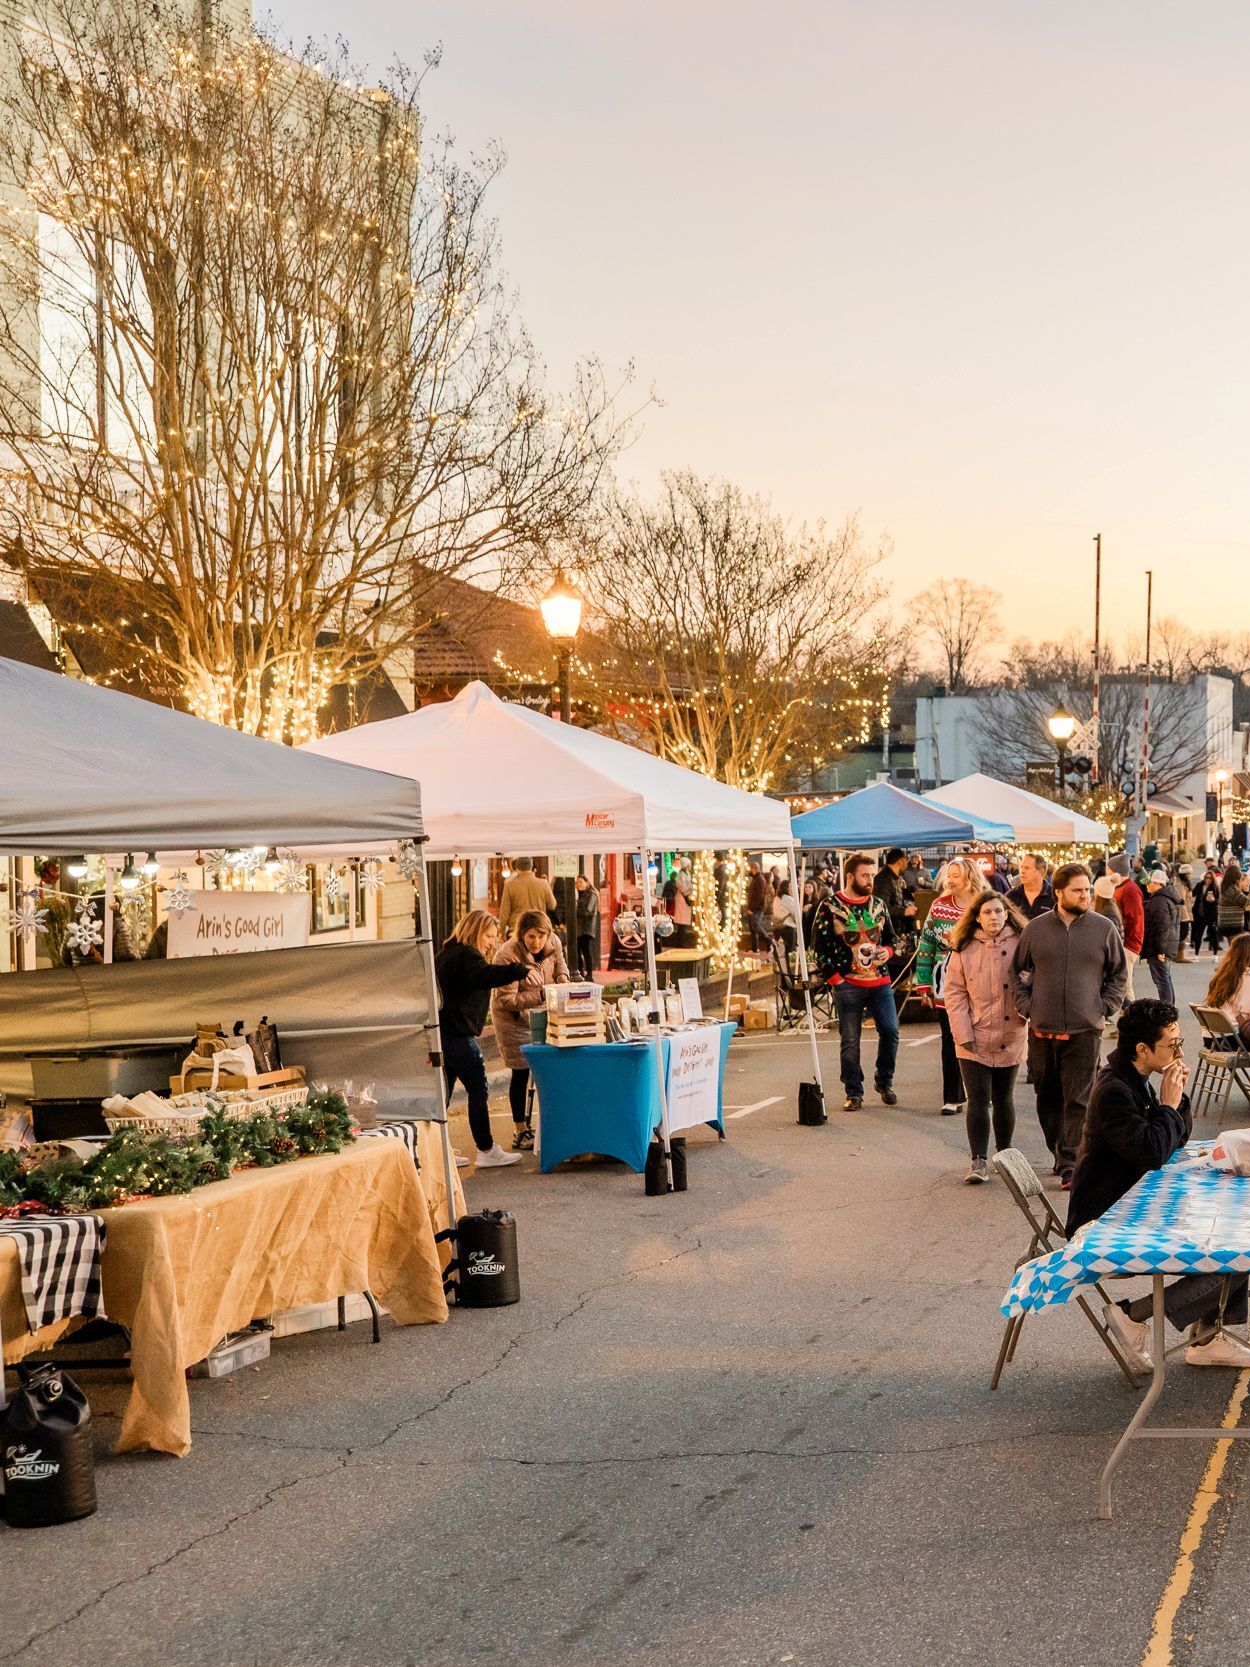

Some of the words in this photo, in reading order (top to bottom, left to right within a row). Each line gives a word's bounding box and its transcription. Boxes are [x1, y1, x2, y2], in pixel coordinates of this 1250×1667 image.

[197, 913, 232, 939] Arin's
[235, 916, 260, 938] Good
[263, 913, 284, 938] Girl
[467, 1264, 506, 1274] TOOKNIN
[5, 1463, 60, 1478] TOOKNIN
